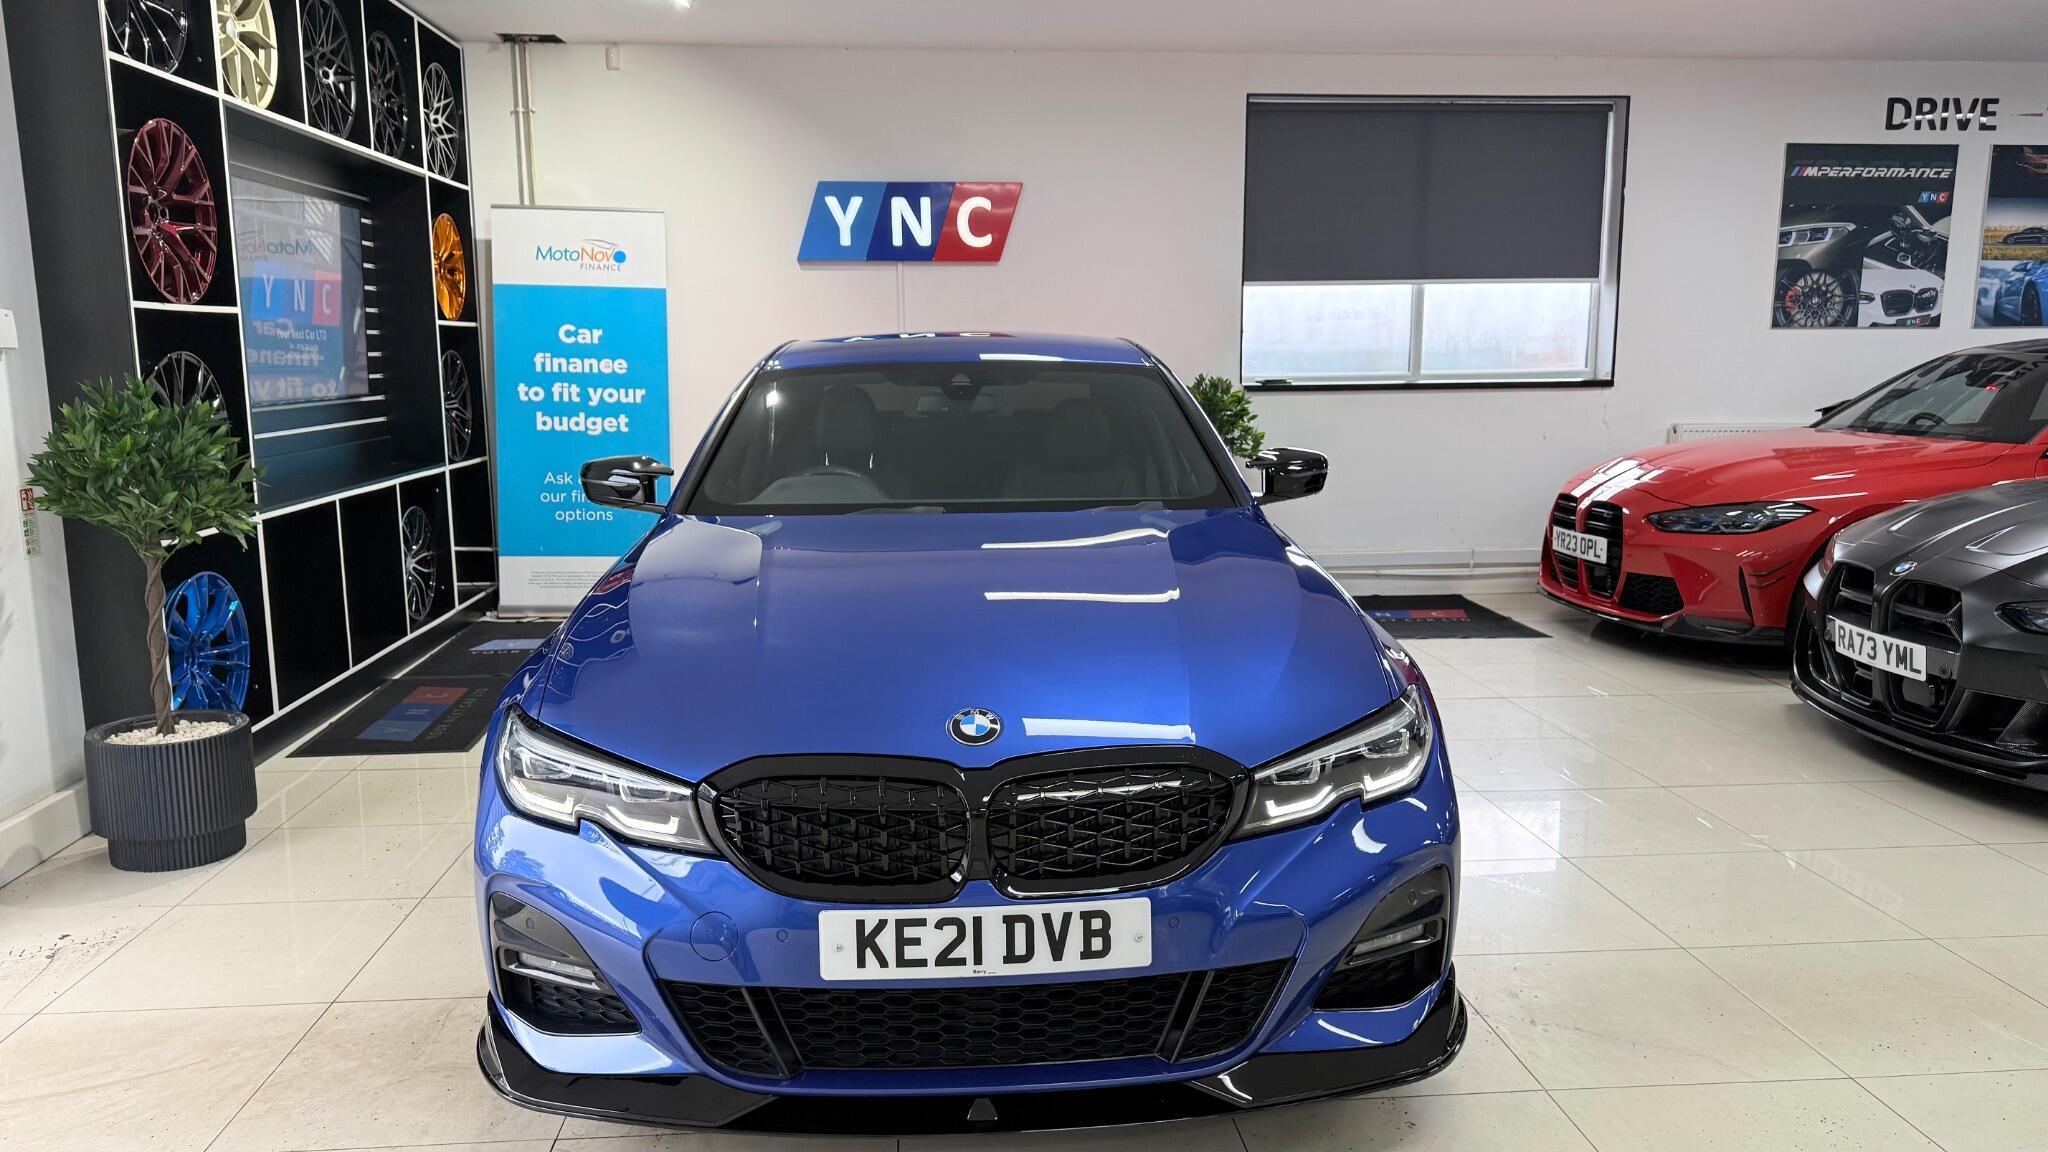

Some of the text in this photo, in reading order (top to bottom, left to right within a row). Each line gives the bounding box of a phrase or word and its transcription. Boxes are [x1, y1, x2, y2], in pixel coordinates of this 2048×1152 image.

[1885, 97, 2000, 131] DRIVE
[1922, 193, 1946, 201] YNC
[824, 196, 993, 247] YNC
[580, 263, 622, 272] FINANCE
[262, 274, 331, 315] YNC
[316, 329, 327, 341] LTD
[558, 323, 603, 344] Car
[533, 352, 628, 374] finance
[517, 382, 646, 407] to fit your
[536, 411, 629, 435] budget
[543, 472, 573, 485] Ask
[540, 491, 567, 503] our
[555, 508, 614, 523] options
[1555, 530, 1601, 558] YR23 OPL
[1838, 624, 1922, 674] RA73 YML
[856, 909, 1112, 968] KE21 DVB
